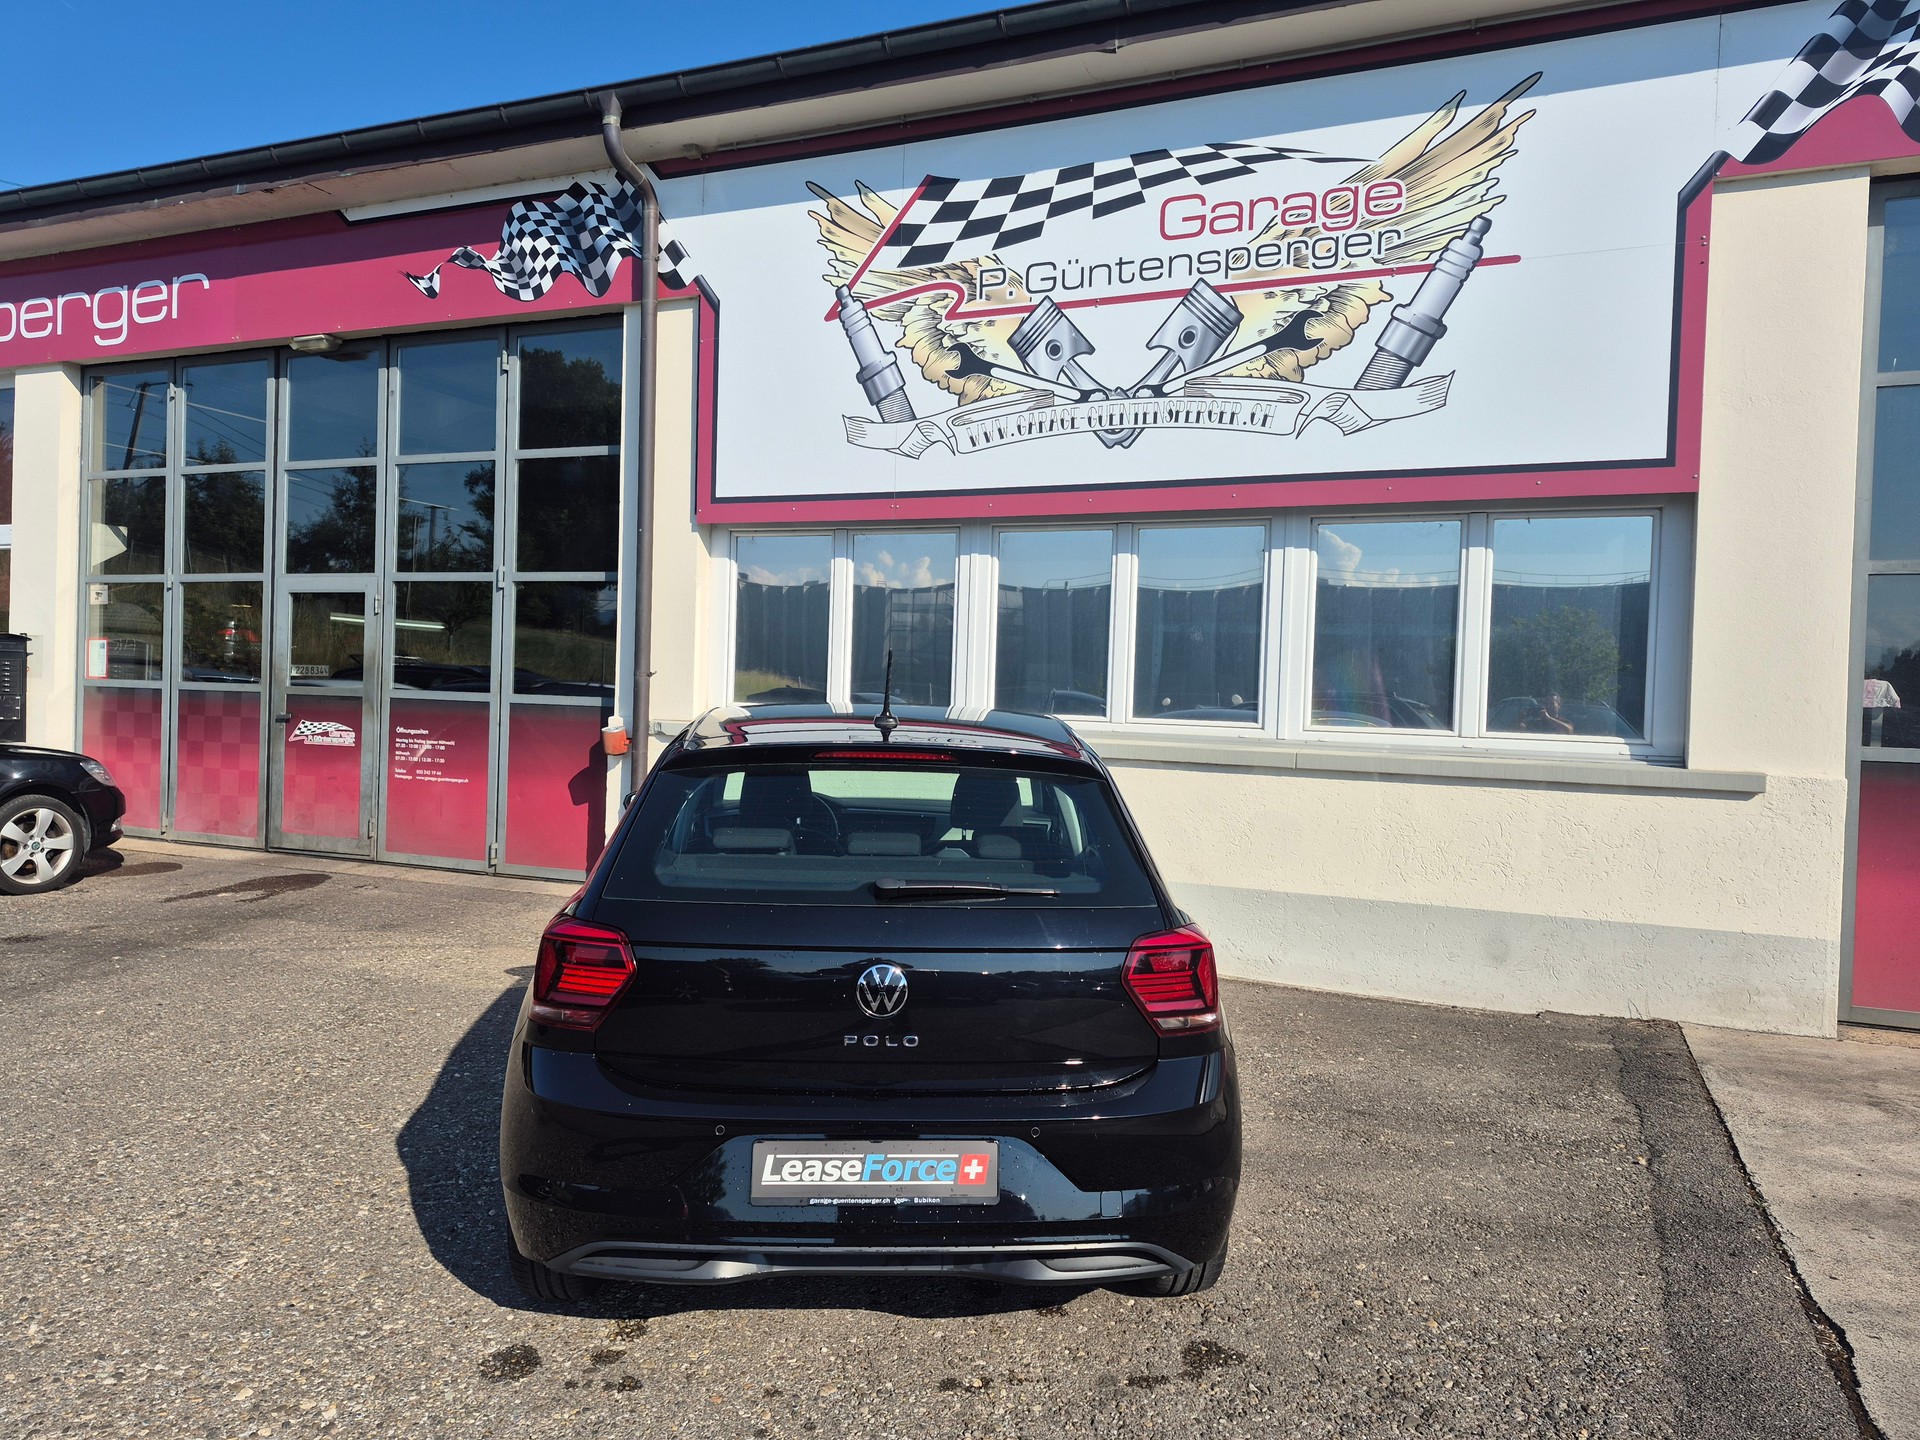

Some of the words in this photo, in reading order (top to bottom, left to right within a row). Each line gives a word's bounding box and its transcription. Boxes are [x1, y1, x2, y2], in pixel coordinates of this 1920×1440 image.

[1160, 180, 1405, 241] Garage
[978, 267, 1014, 299] P.
[1025, 228, 1402, 294] Güntensperger
[966, 400, 1278, 447] WWW.GARAGE-GUENTENSPERGER.CH
[844, 1035, 919, 1047] POLO
[761, 1153, 958, 1183] LeaseForce
[913, 1196, 941, 1204] Bubikon
